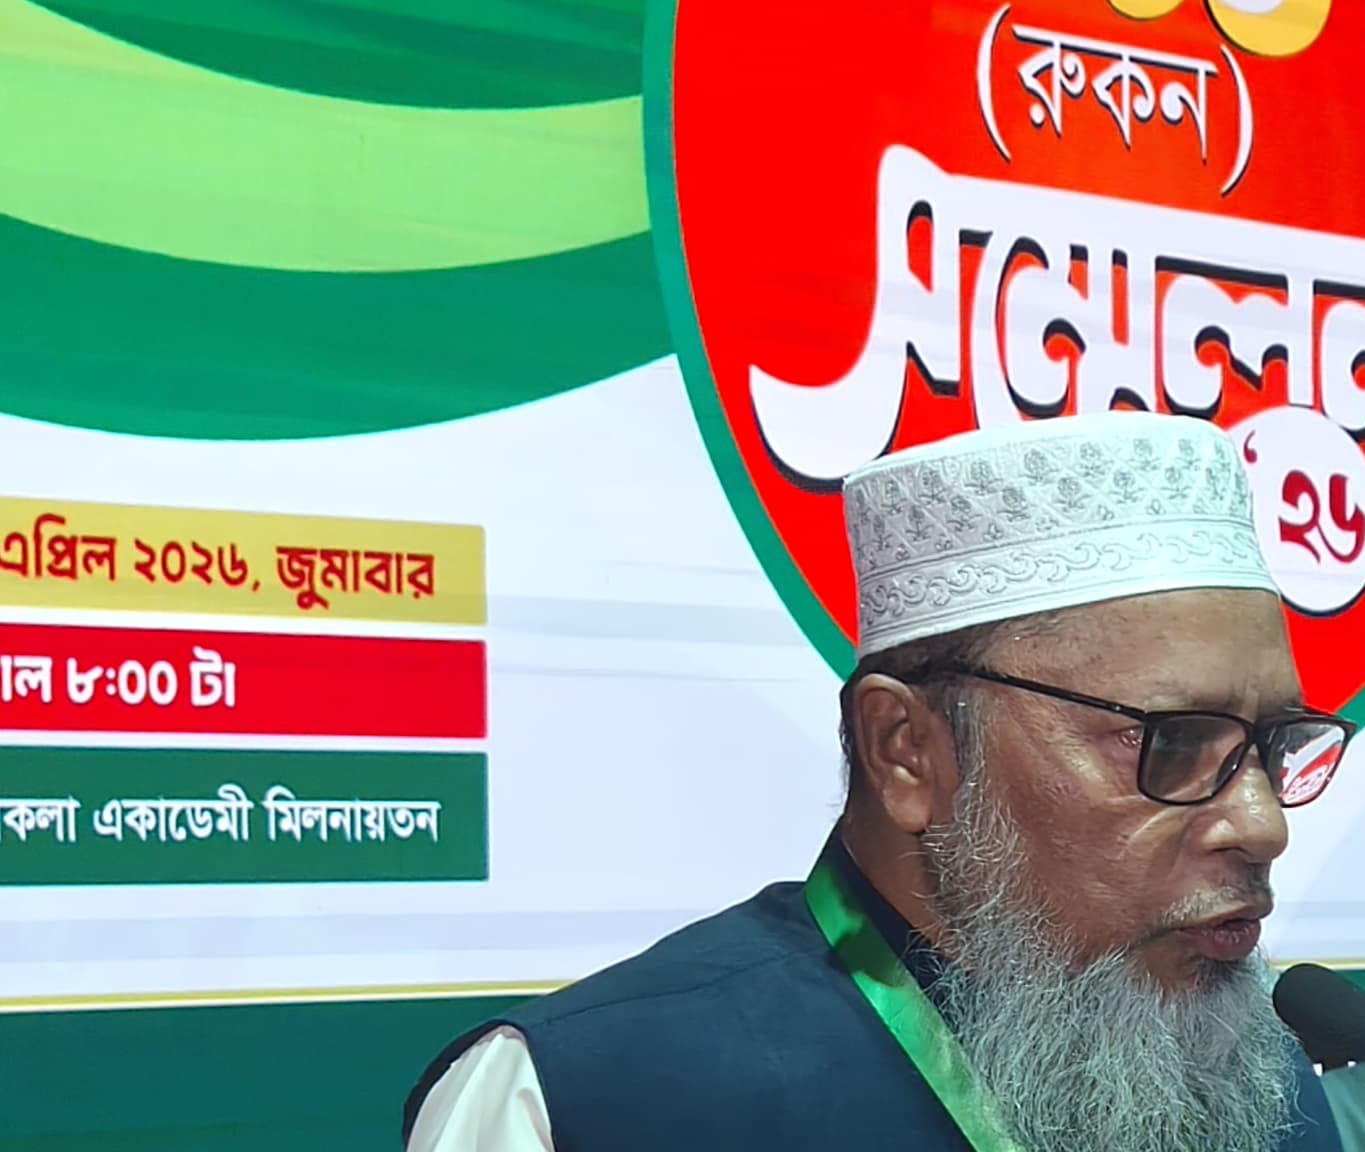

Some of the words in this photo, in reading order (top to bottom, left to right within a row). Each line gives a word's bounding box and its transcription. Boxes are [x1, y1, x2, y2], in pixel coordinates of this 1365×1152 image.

[977, 8, 1254, 197] (রুকন)
[0, 514, 116, 581] এপ্রিল
[134, 539, 260, 592] ২০২৬,
[276, 545, 436, 610] জুমাবার
[0, 654, 53, 704] াল
[189, 646, 237, 708] টা
[0, 795, 81, 842] কলা
[93, 782, 254, 843] একাডেমী
